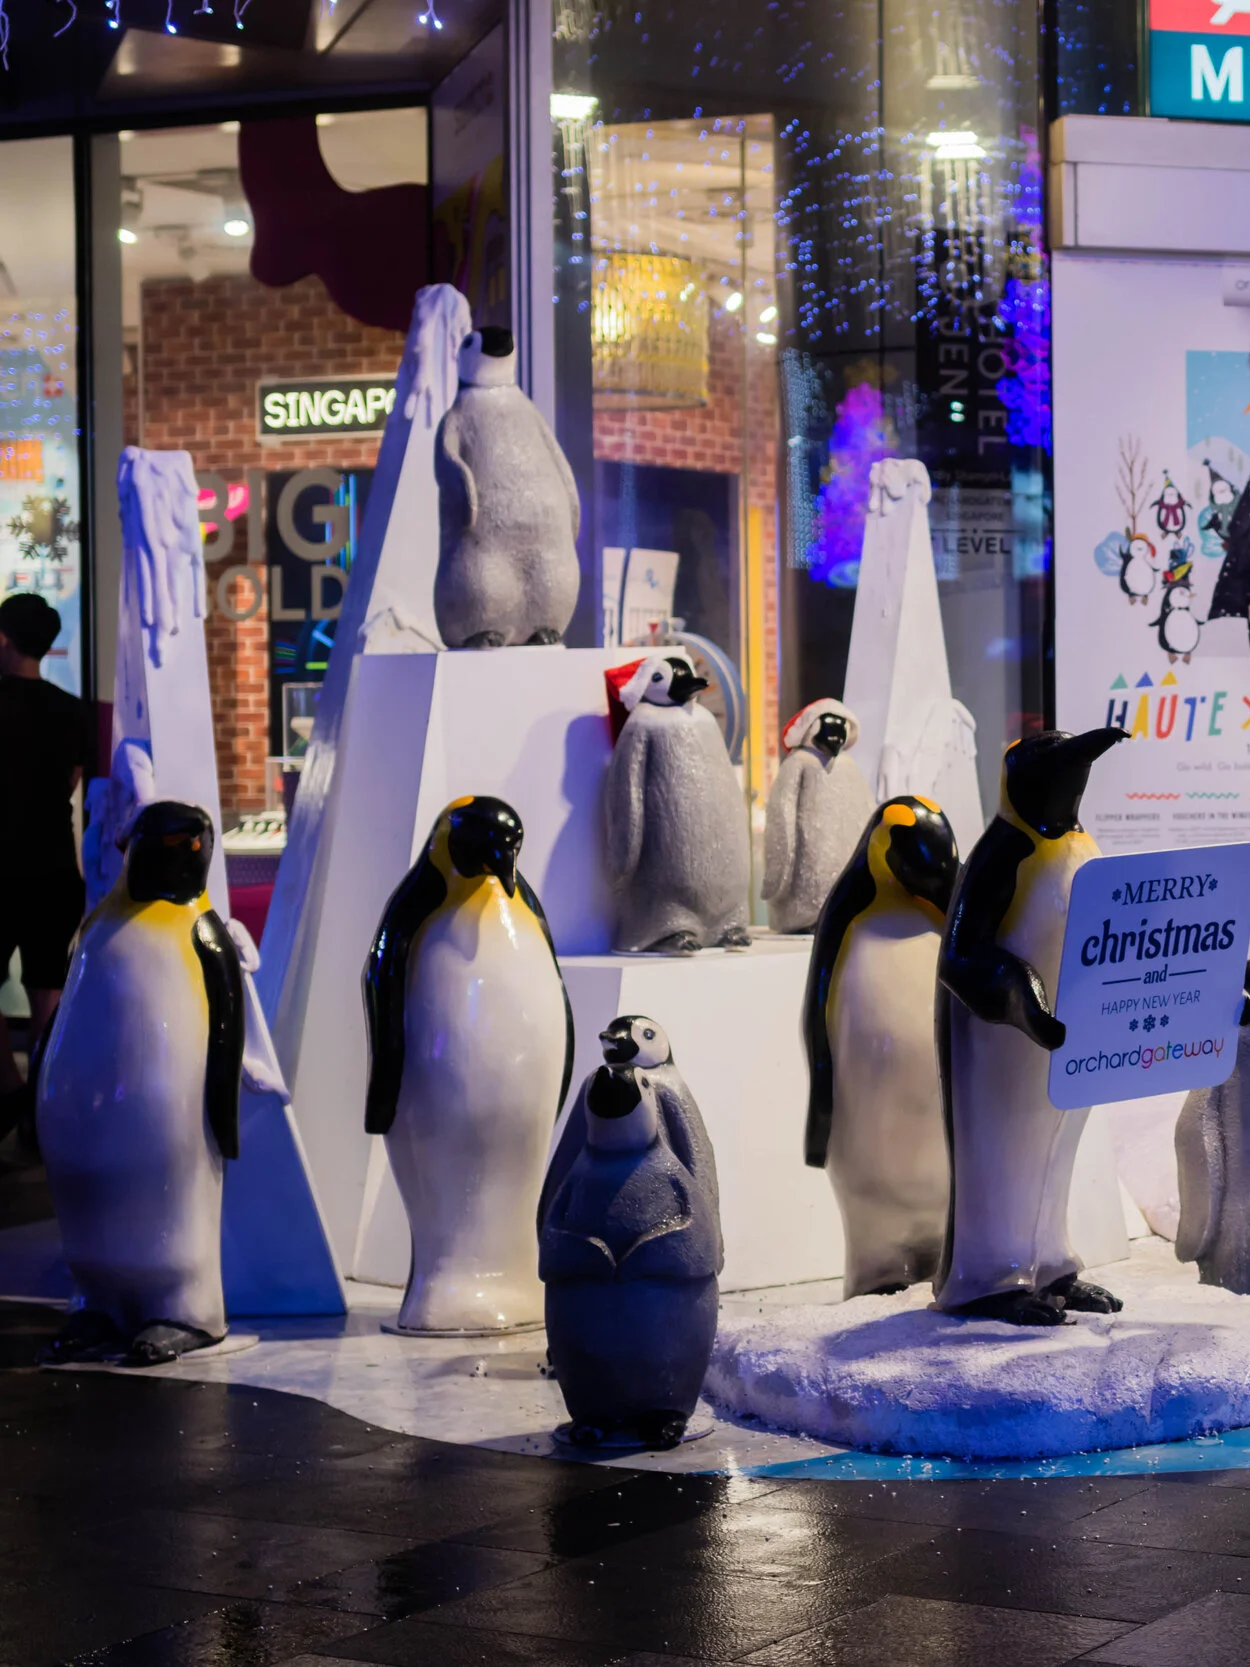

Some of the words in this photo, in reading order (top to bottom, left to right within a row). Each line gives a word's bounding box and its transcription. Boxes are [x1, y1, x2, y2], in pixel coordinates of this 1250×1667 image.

[943, 537, 1011, 554] LEVEL
[215, 563, 350, 622] OLD
[1104, 691, 1228, 742] HAUTE
[1122, 874, 1212, 906] MERRY
[1081, 918, 1236, 967] christmas
[1143, 963, 1168, 984] and
[1101, 999, 1139, 1015] HAPPY
[1142, 994, 1171, 1009] NEW
[1171, 990, 1200, 1005] YEAR
[1066, 1037, 1224, 1075] orchardgateway
